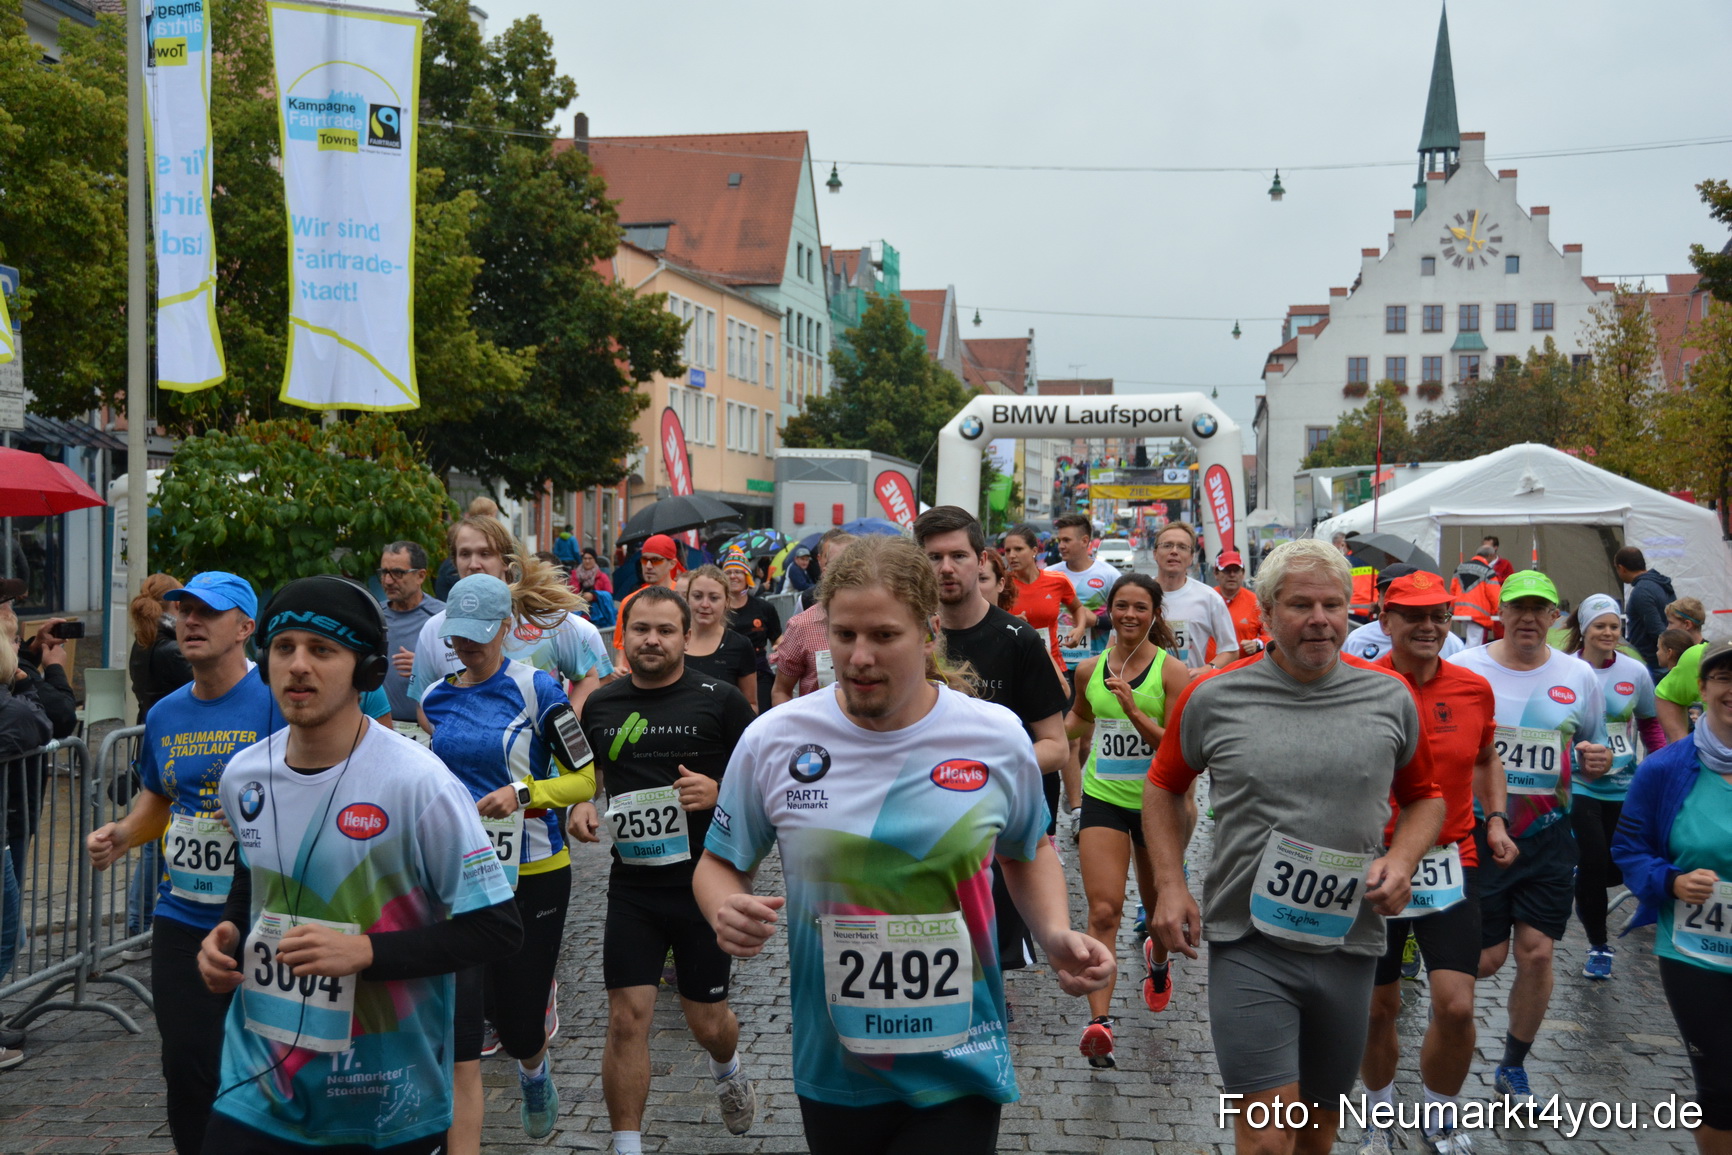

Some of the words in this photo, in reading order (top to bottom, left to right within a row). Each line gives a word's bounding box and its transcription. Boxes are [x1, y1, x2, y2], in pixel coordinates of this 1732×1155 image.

[288, 98, 356, 114] Kampagne
[289, 111, 363, 130] Fairtrade
[320, 133, 358, 147] Towns
[369, 138, 400, 148] FAIRTRADE
[291, 214, 330, 237] Wir
[338, 218, 381, 242] sind
[993, 404, 1058, 424] BMW
[1065, 404, 1182, 427] Laufsport
[1129, 488, 1152, 496] ZIEL
[1208, 472, 1233, 535] REWE
[1057, 633, 1087, 649] 24
[1551, 688, 1574, 701] Hervis
[161, 736, 173, 747] 10.
[174, 730, 257, 745] NEUMARKTER
[1521, 729, 1555, 740] BOCK
[169, 742, 236, 758] STADTLAUF
[1102, 733, 1154, 757] 3025
[632, 751, 652, 759] Secure
[653, 750, 669, 758] Cloud
[670, 750, 699, 758] Solutions
[1495, 740, 1555, 771] 2410
[940, 766, 983, 784] Hervis
[1507, 773, 1535, 786] Erwin
[636, 789, 675, 802] BOCK
[786, 789, 829, 801] PARTL
[786, 801, 829, 810] Neumarkt
[343, 811, 382, 831] Hervis
[612, 805, 680, 839] 2532
[173, 836, 239, 871] 2364
[633, 843, 665, 856] Daniel
[1276, 844, 1314, 862] NeuerMarkt
[1319, 852, 1365, 869] BOCK
[193, 878, 213, 891] Jan
[1266, 860, 1359, 911] 3084
[1412, 894, 1434, 906] Karl
[1272, 907, 1321, 928] Stephan
[833, 931, 879, 940] NeuerMarkt
[887, 919, 959, 937] BOCK
[839, 948, 960, 1000] 2492
[865, 1014, 933, 1034] Florian
[942, 1035, 999, 1059] Stadtlauf
[328, 1048, 362, 1072] 17.
[326, 1067, 403, 1085] Neumarkter
[326, 1084, 390, 1098] Stadtlauf
